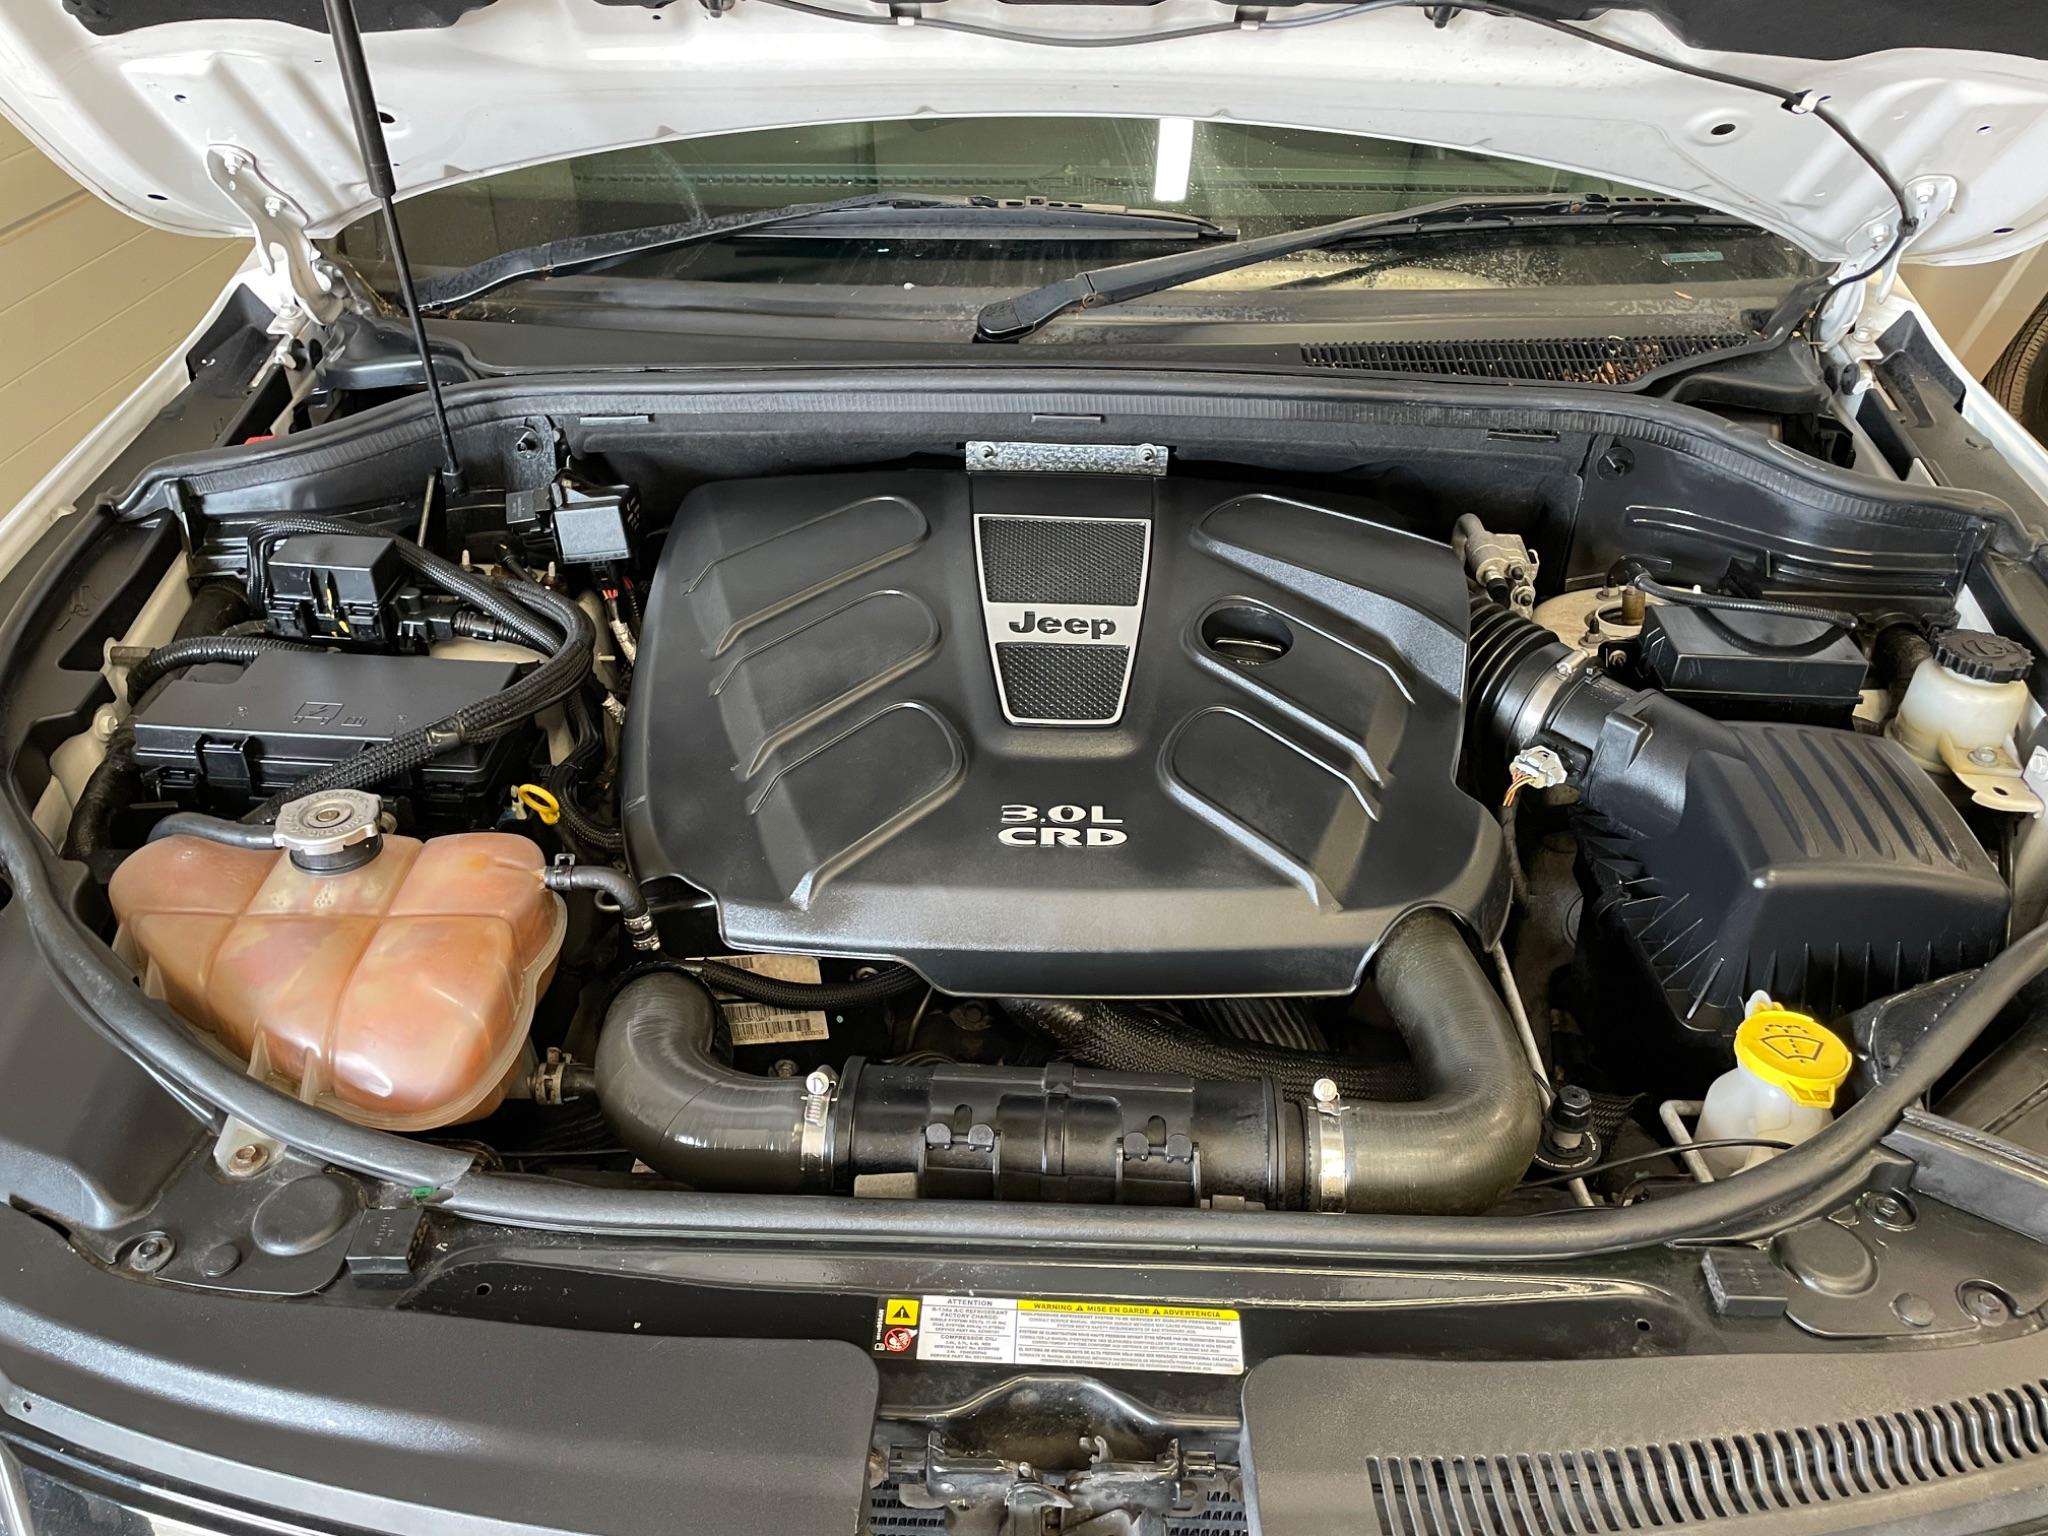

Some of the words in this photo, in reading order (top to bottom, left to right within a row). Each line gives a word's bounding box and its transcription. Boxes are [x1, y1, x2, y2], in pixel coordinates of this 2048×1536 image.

[1009, 611, 1117, 640] Jeep
[1001, 804, 1124, 825] 3.0L
[997, 827, 1128, 849] CRD
[947, 1298, 993, 1307] ATTENTION
[1033, 1303, 1072, 1311] WARNING
[1122, 1306, 1150, 1314] GARDE
[1163, 1308, 1221, 1317] ADVERTENCIA
